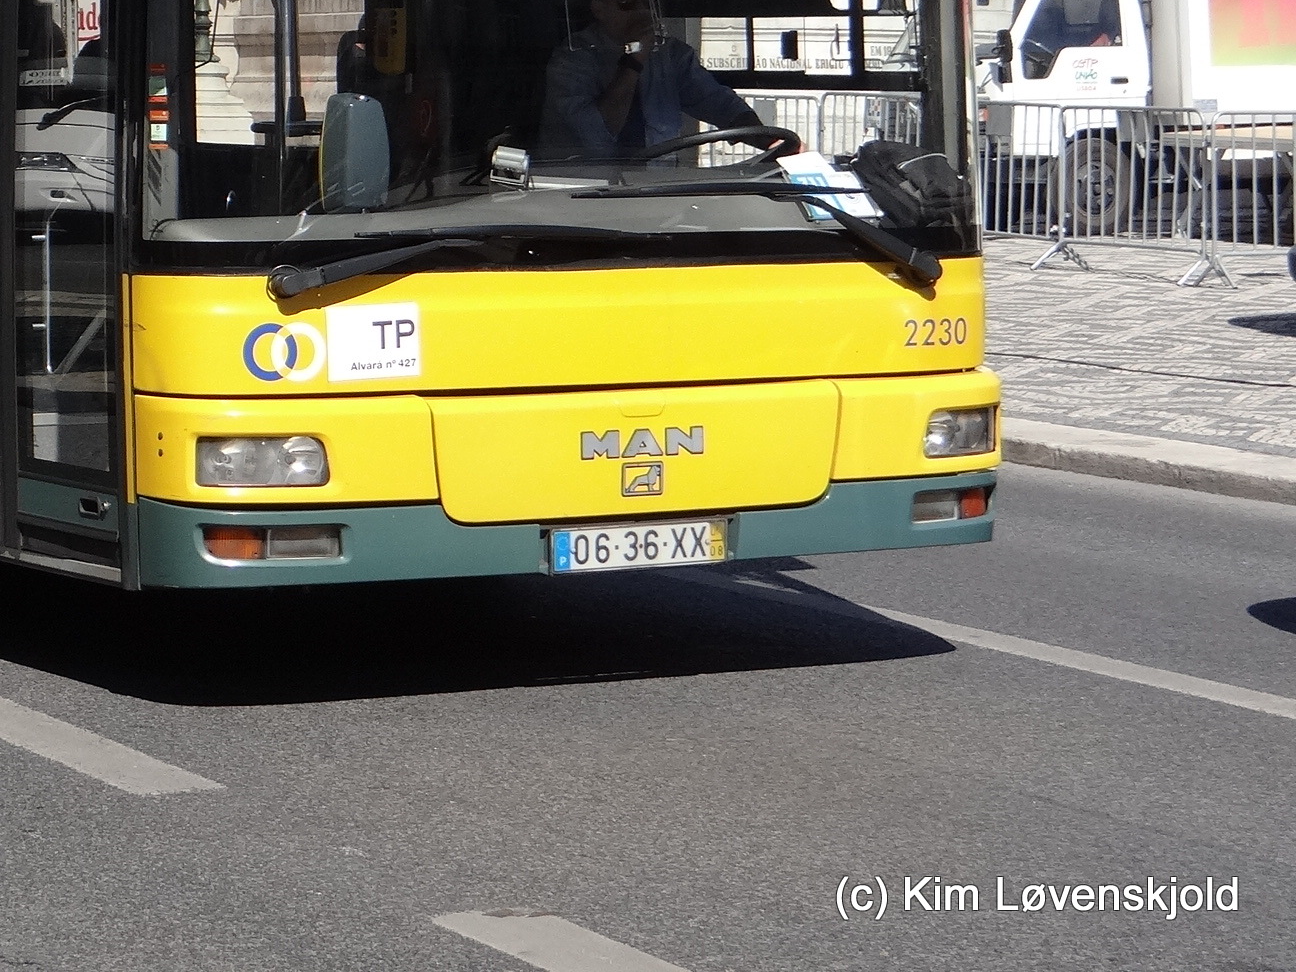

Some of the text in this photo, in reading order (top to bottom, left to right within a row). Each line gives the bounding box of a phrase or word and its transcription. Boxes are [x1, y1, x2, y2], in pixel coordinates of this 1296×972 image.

[769, 56, 812, 70] NACIONAL
[372, 319, 415, 349] TP
[904, 318, 967, 346] 2230
[350, 360, 383, 371] Alvará
[398, 358, 416, 368] 427
[580, 425, 704, 460] MAN
[710, 545, 723, 557] 08
[559, 556, 567, 566] P
